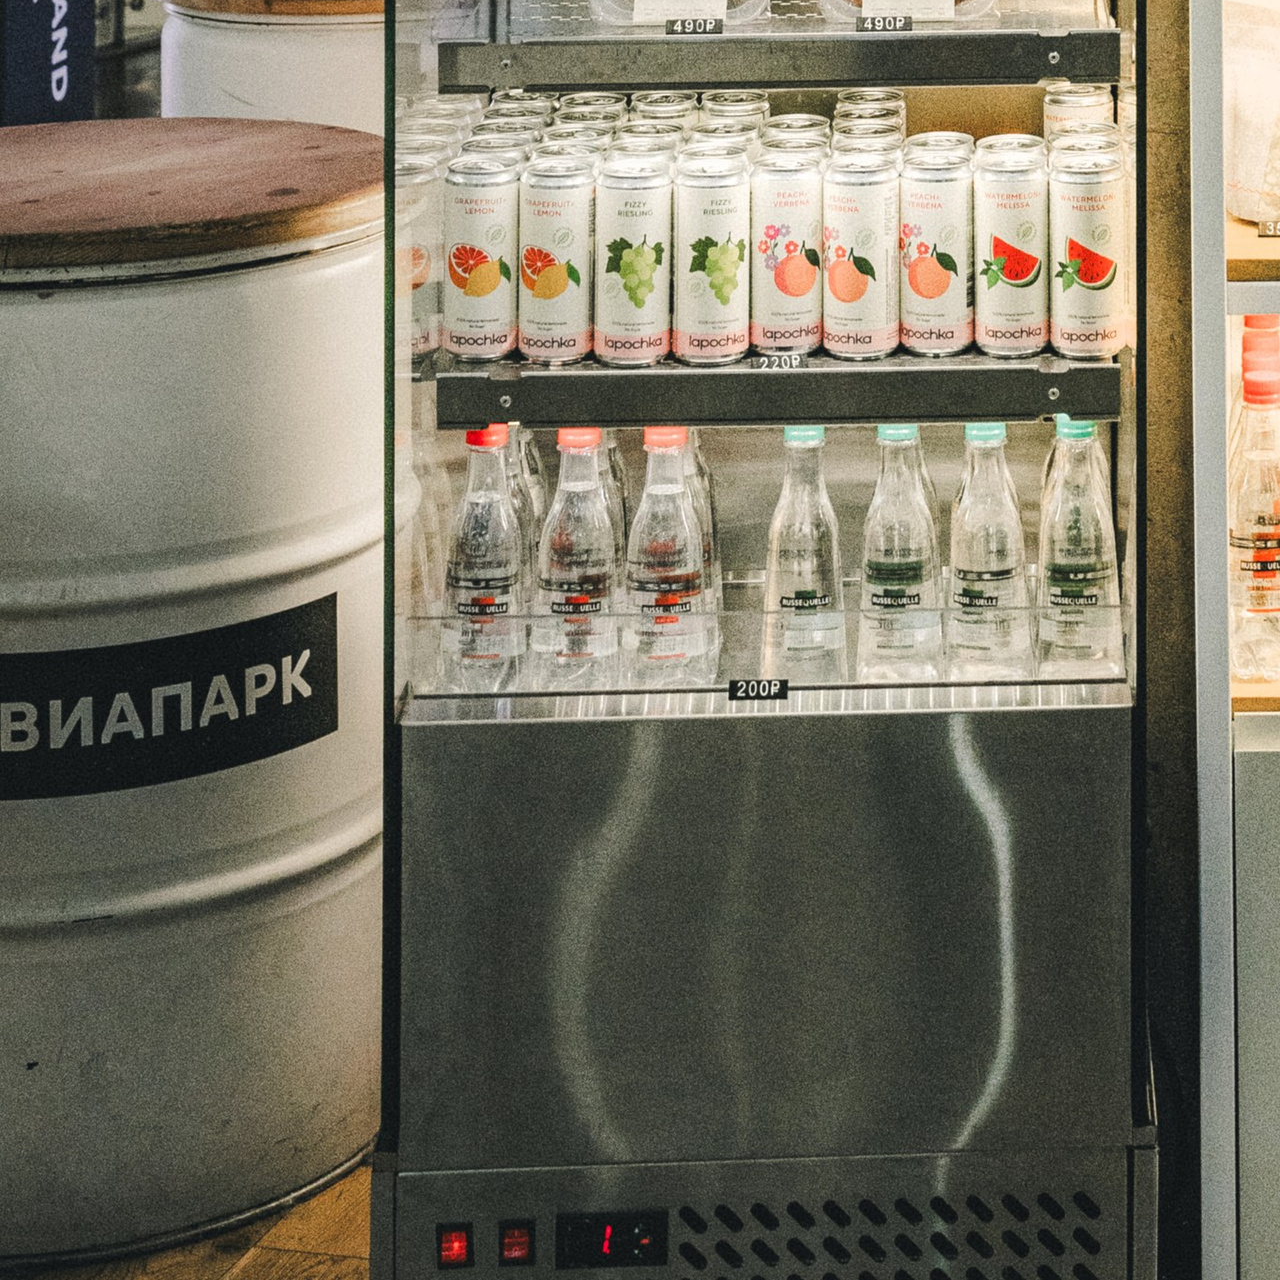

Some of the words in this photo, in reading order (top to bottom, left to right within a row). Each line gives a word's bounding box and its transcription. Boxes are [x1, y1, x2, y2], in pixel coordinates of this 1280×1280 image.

[773, 199, 810, 208] VERBENA
[996, 202, 1030, 210] MELISSA
[450, 330, 508, 348] lapochka
[762, 324, 819, 340] lapochka
[985, 326, 1042, 341] lapochka
[689, 333, 745, 351] lapochka
